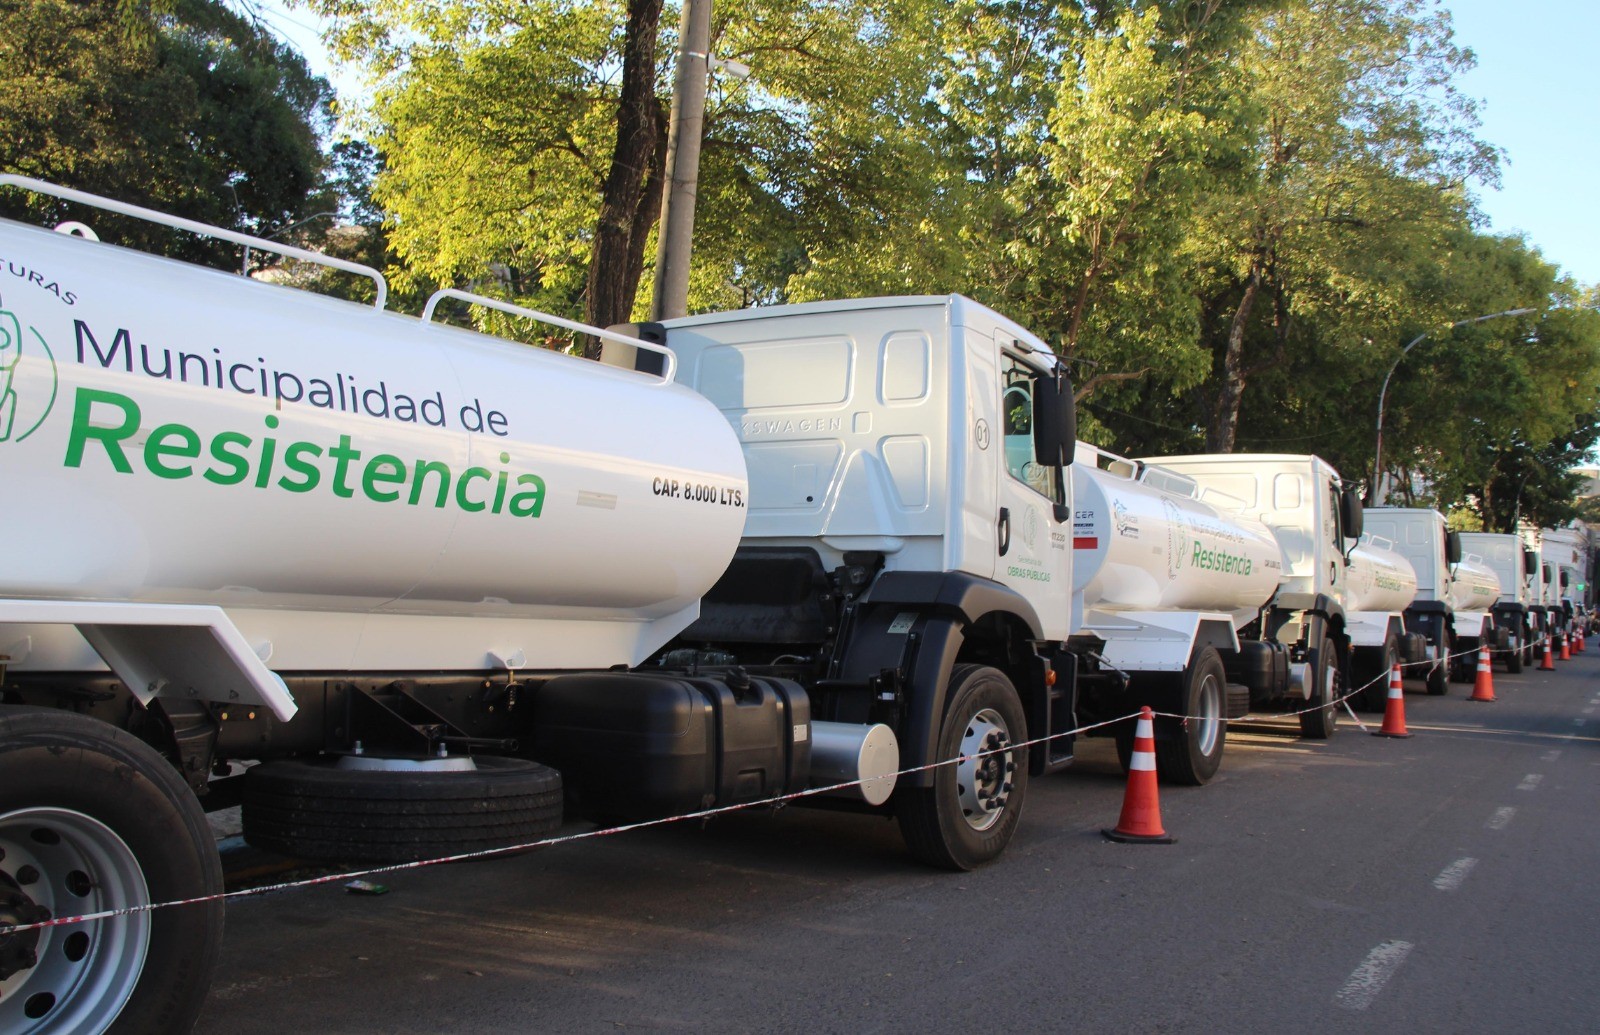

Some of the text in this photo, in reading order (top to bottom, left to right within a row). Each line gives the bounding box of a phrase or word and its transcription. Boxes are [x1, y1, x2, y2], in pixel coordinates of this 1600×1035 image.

[73, 319, 510, 437] Municipalidad de
[63, 387, 548, 519] Resistencia
[652, 476, 745, 508] CAP. 8.000 LTS.
[1007, 565, 1052, 582] OBRAS PÚBLICAS
[1190, 540, 1252, 576] Resistencia
